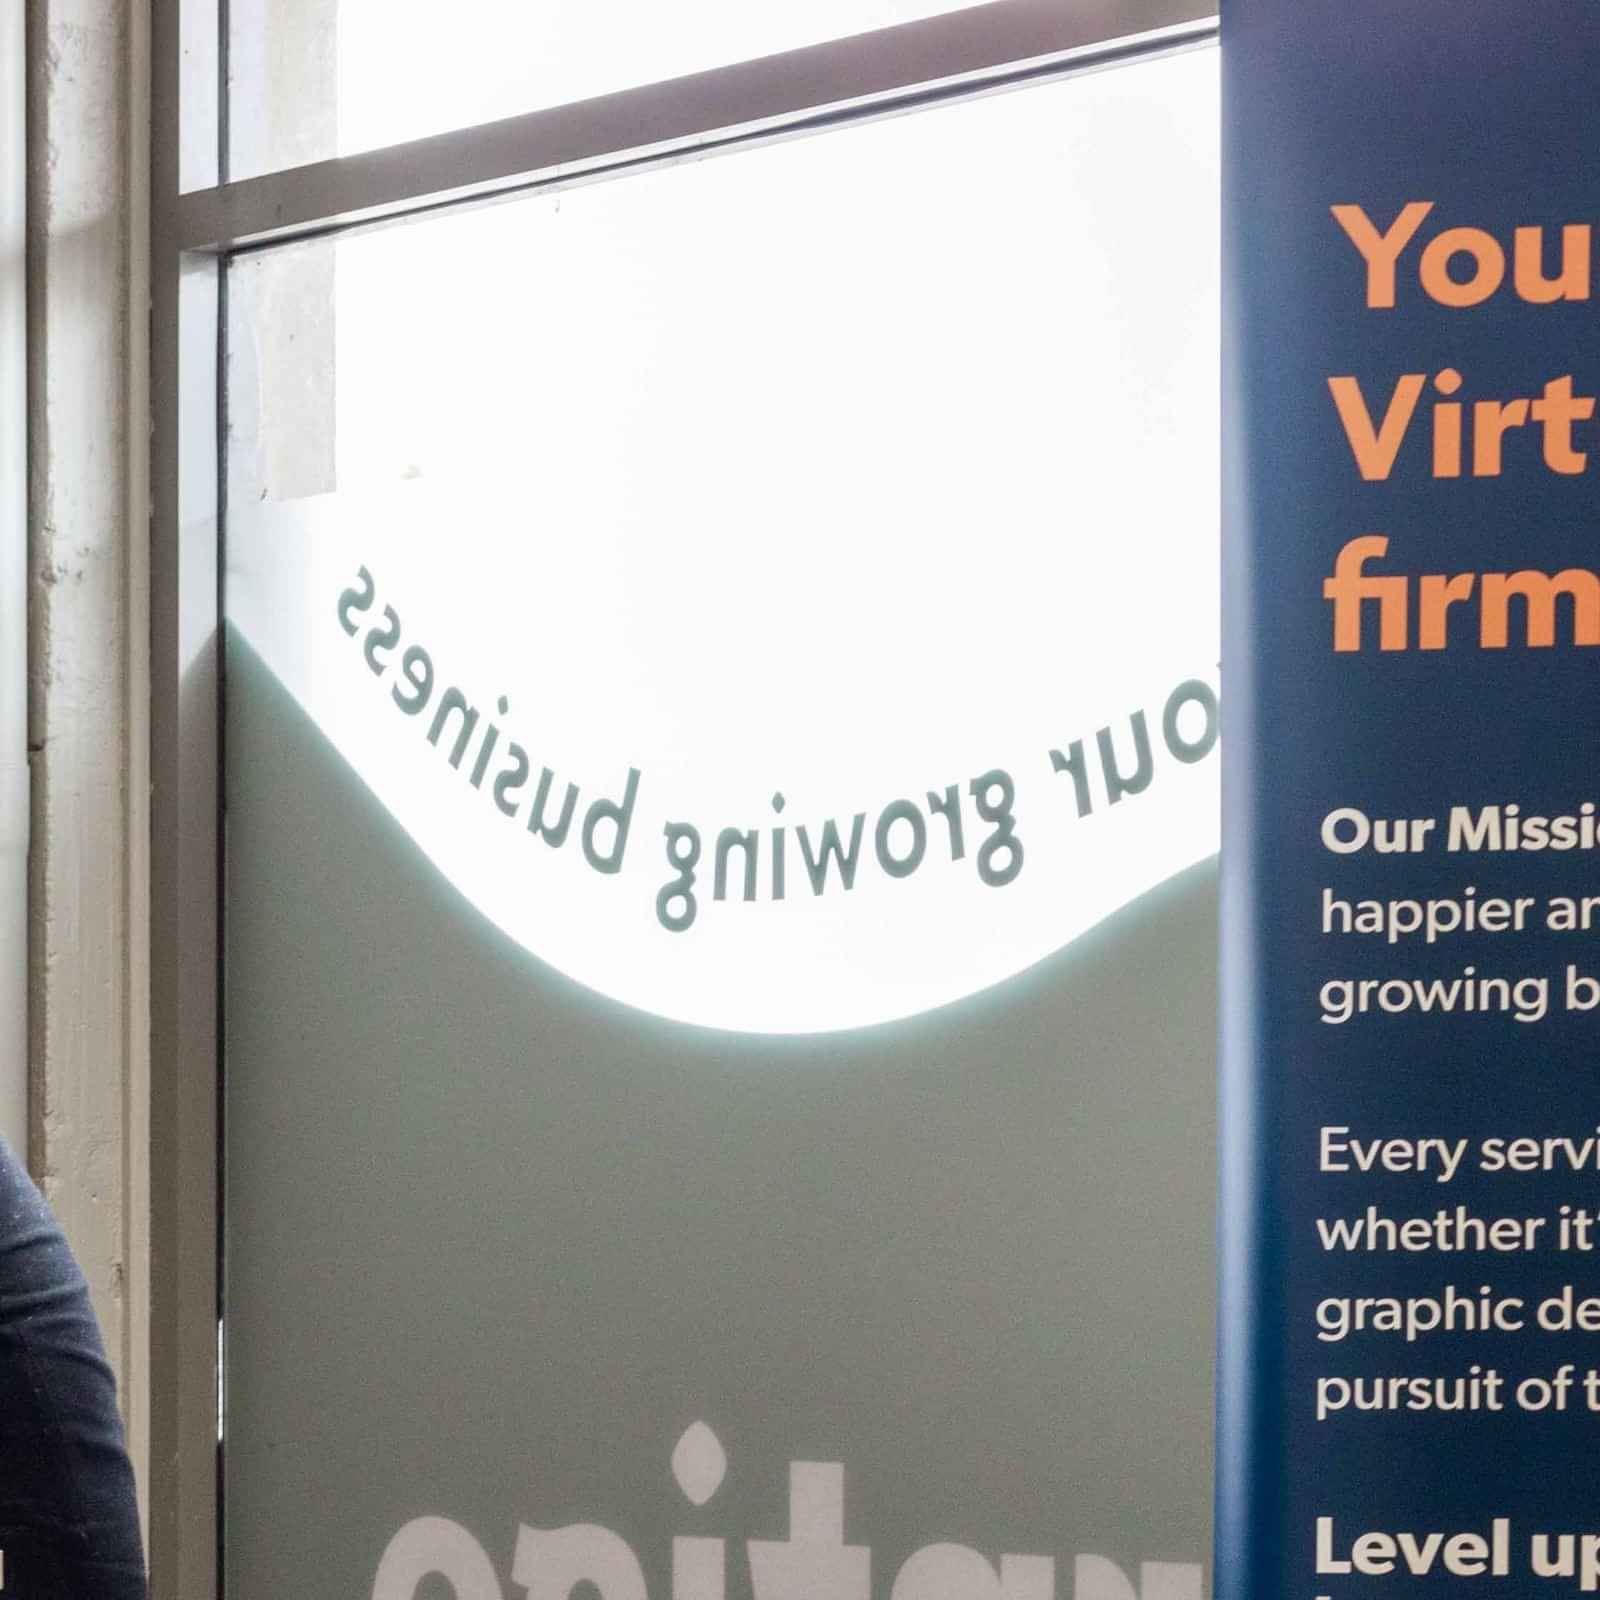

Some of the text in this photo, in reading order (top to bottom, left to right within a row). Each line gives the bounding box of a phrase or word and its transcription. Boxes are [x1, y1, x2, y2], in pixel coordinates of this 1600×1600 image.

[1330, 202, 1591, 308] You
[1327, 368, 1596, 481] Virt
[1323, 535, 1600, 652] firm
[1321, 802, 1600, 854] Our Missi
[1322, 886, 1535, 944] happier
[1319, 966, 1548, 1025] growing
[1319, 1126, 1468, 1183] Every
[1316, 1205, 1546, 1251] whether
[1316, 1285, 1524, 1342] graphic
[1316, 1365, 1504, 1421] pursuit
[1516, 1364, 1575, 1411] of
[1316, 1516, 1510, 1576] Level
